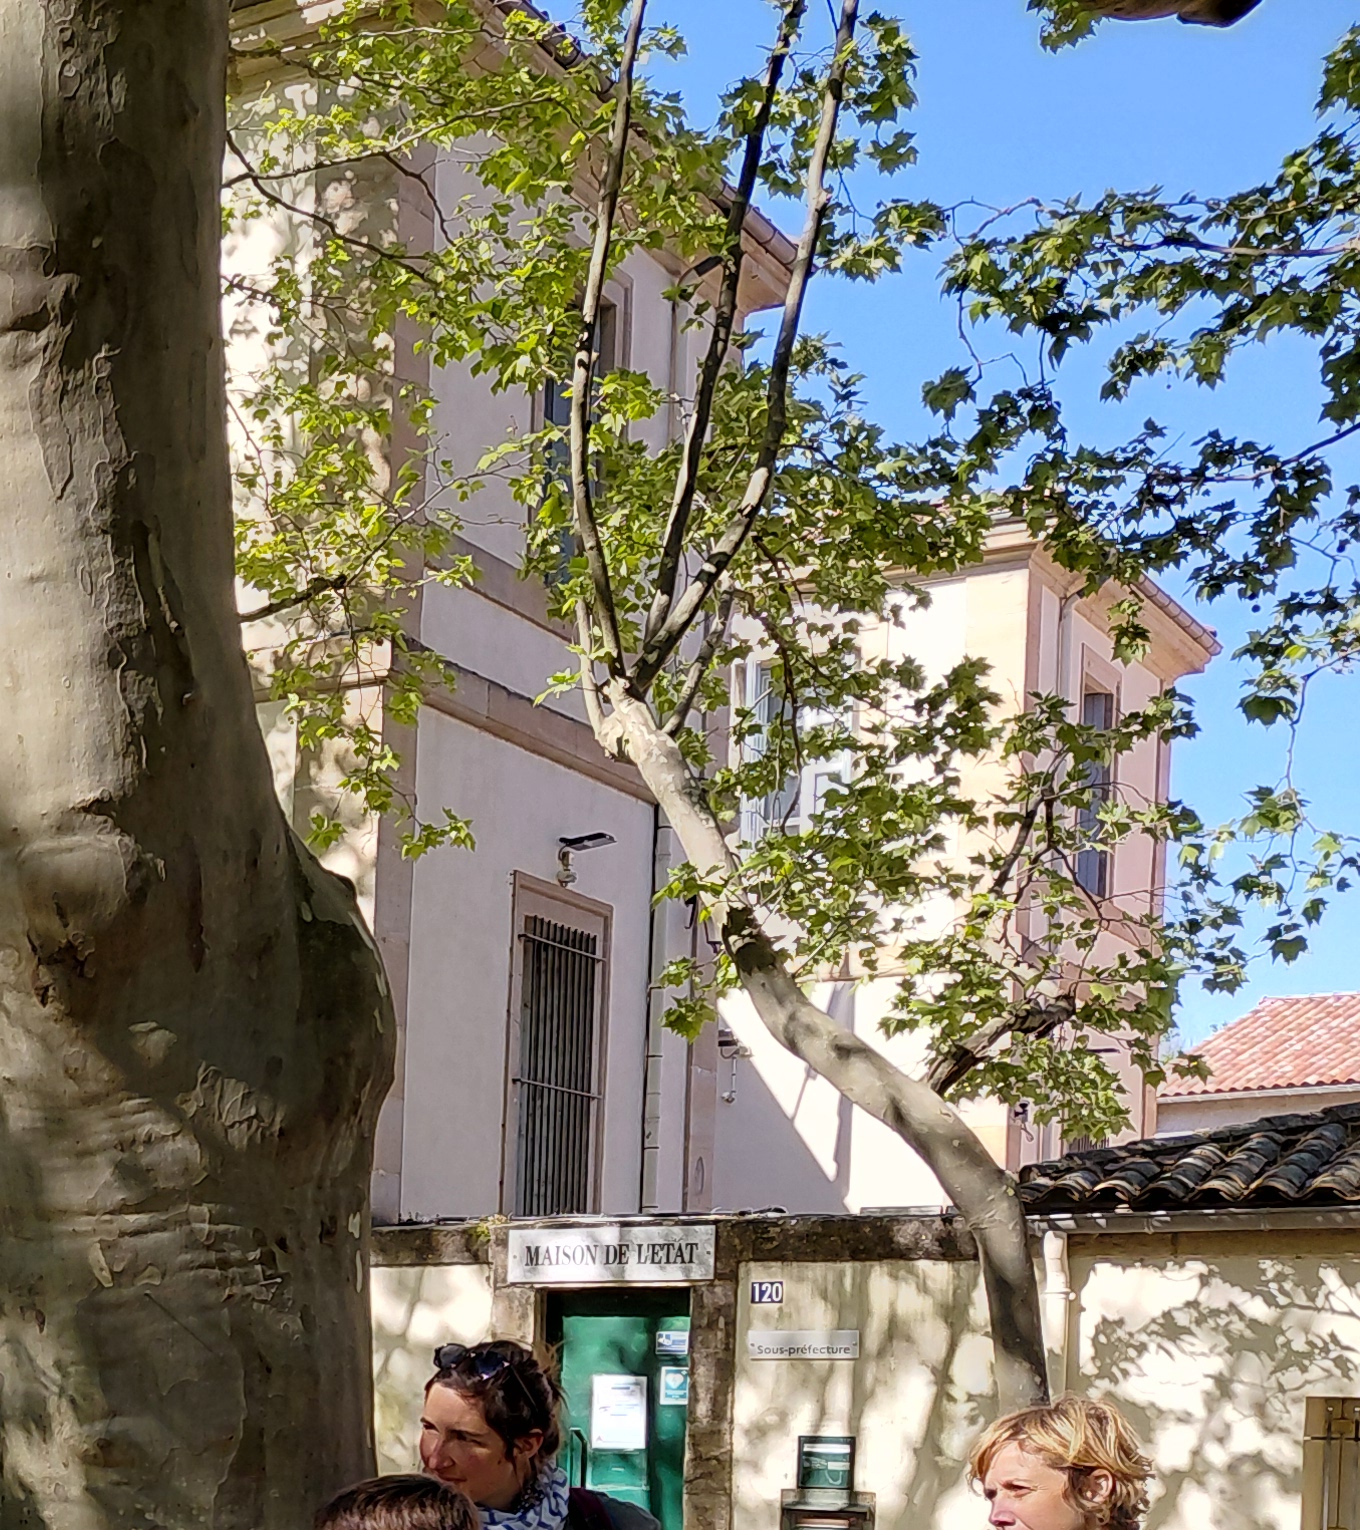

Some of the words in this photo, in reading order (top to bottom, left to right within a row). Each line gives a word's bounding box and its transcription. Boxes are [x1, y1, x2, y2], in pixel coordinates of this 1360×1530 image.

[524, 1243, 599, 1267] MAISON
[603, 1242, 630, 1265] DE
[752, 1282, 783, 1303] 120
[756, 1344, 851, 1357] Sous-préfecture
